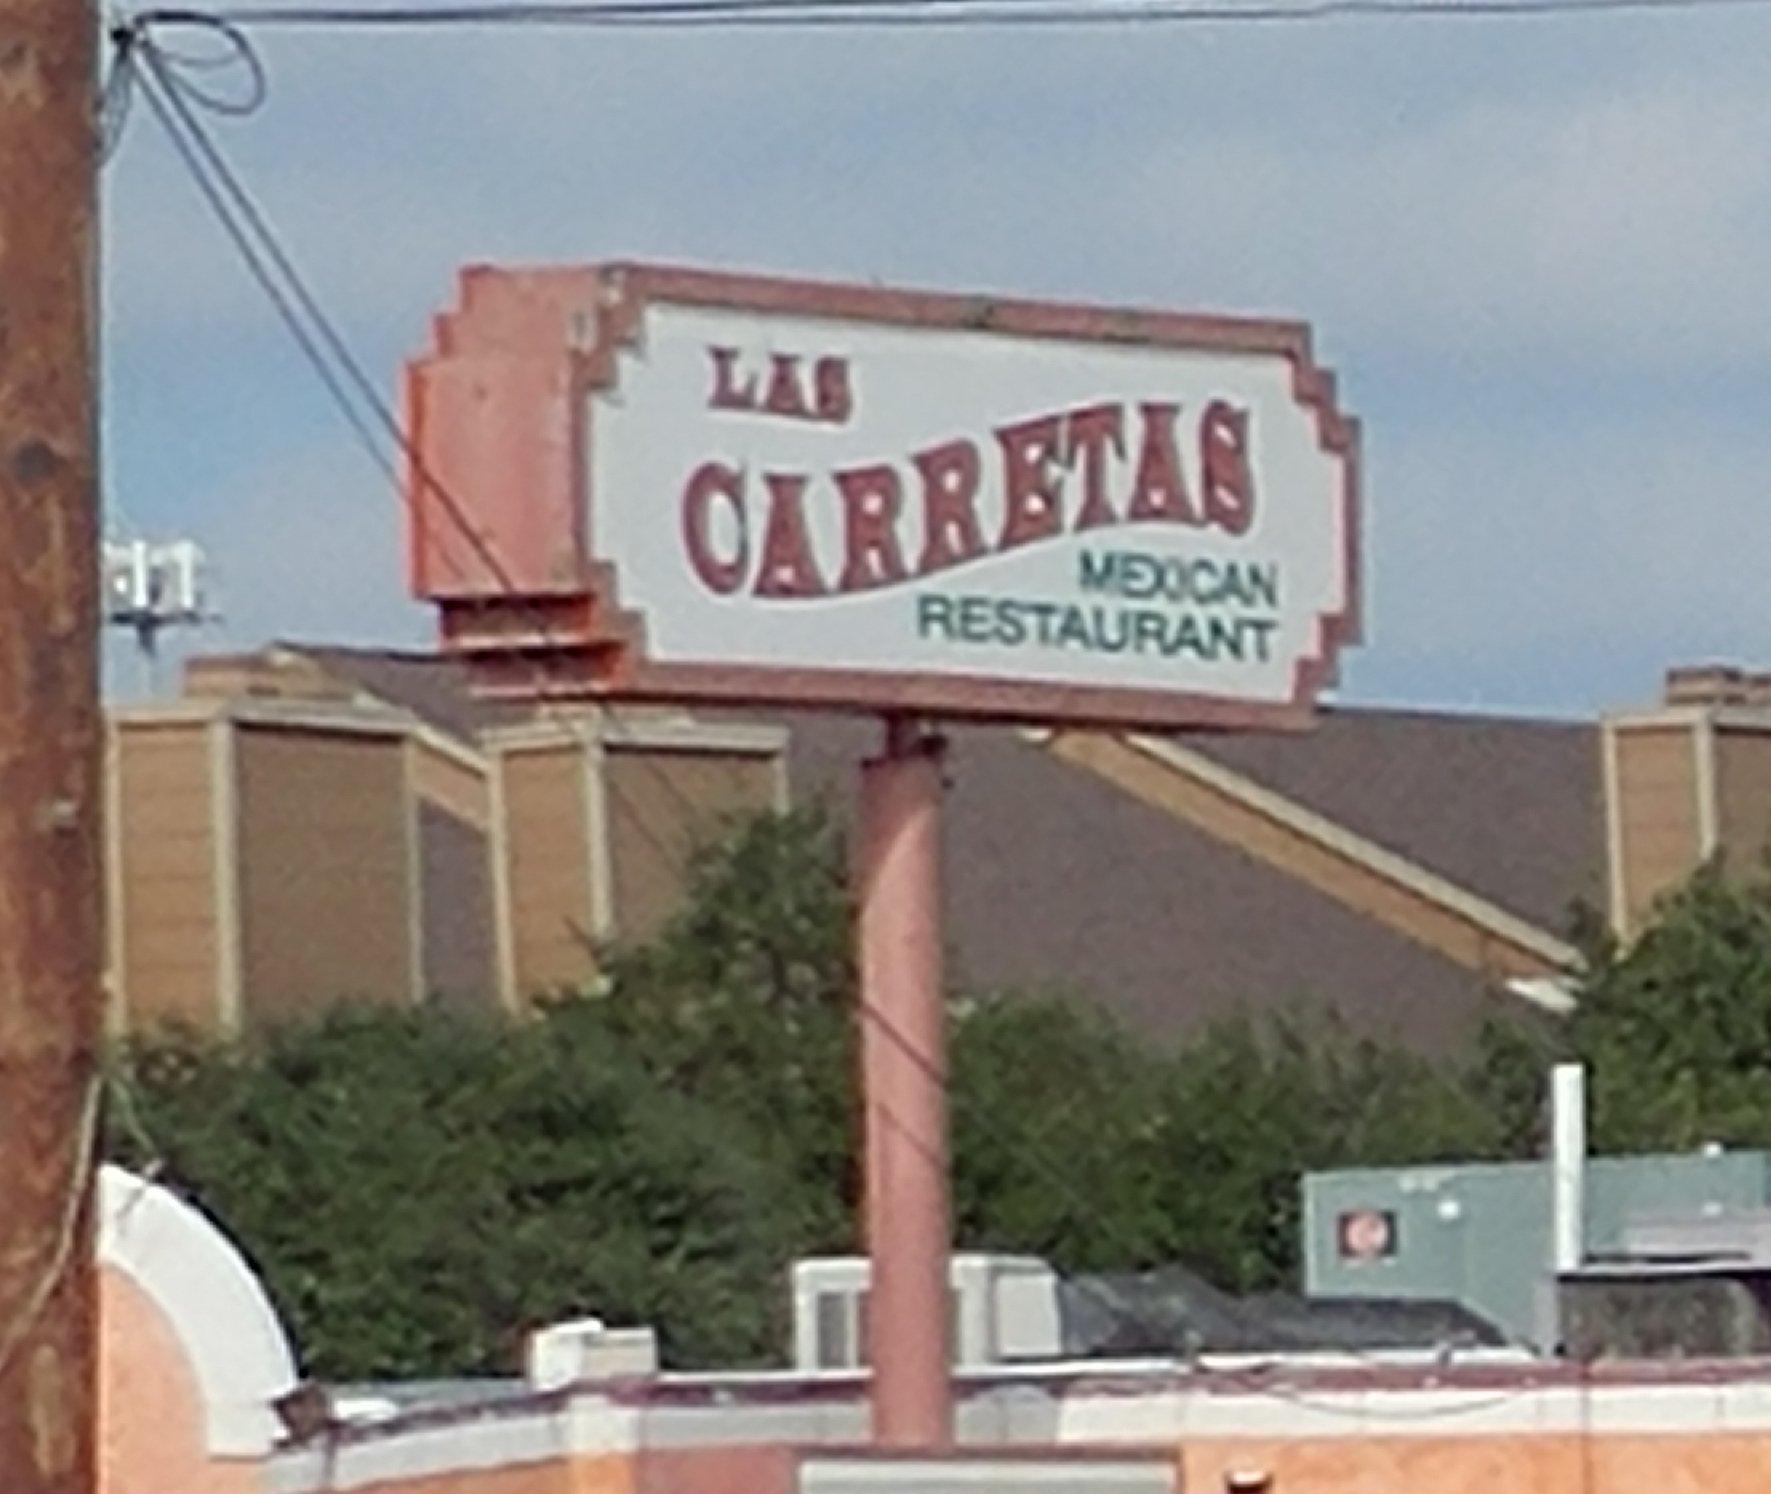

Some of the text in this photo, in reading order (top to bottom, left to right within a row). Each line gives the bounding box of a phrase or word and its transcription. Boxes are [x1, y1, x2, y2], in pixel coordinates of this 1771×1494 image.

[709, 346, 851, 423] LAS
[683, 400, 1254, 598] CARRETAS
[1078, 551, 1278, 605] MEXICAN
[918, 597, 1278, 661] RESTAURANT
